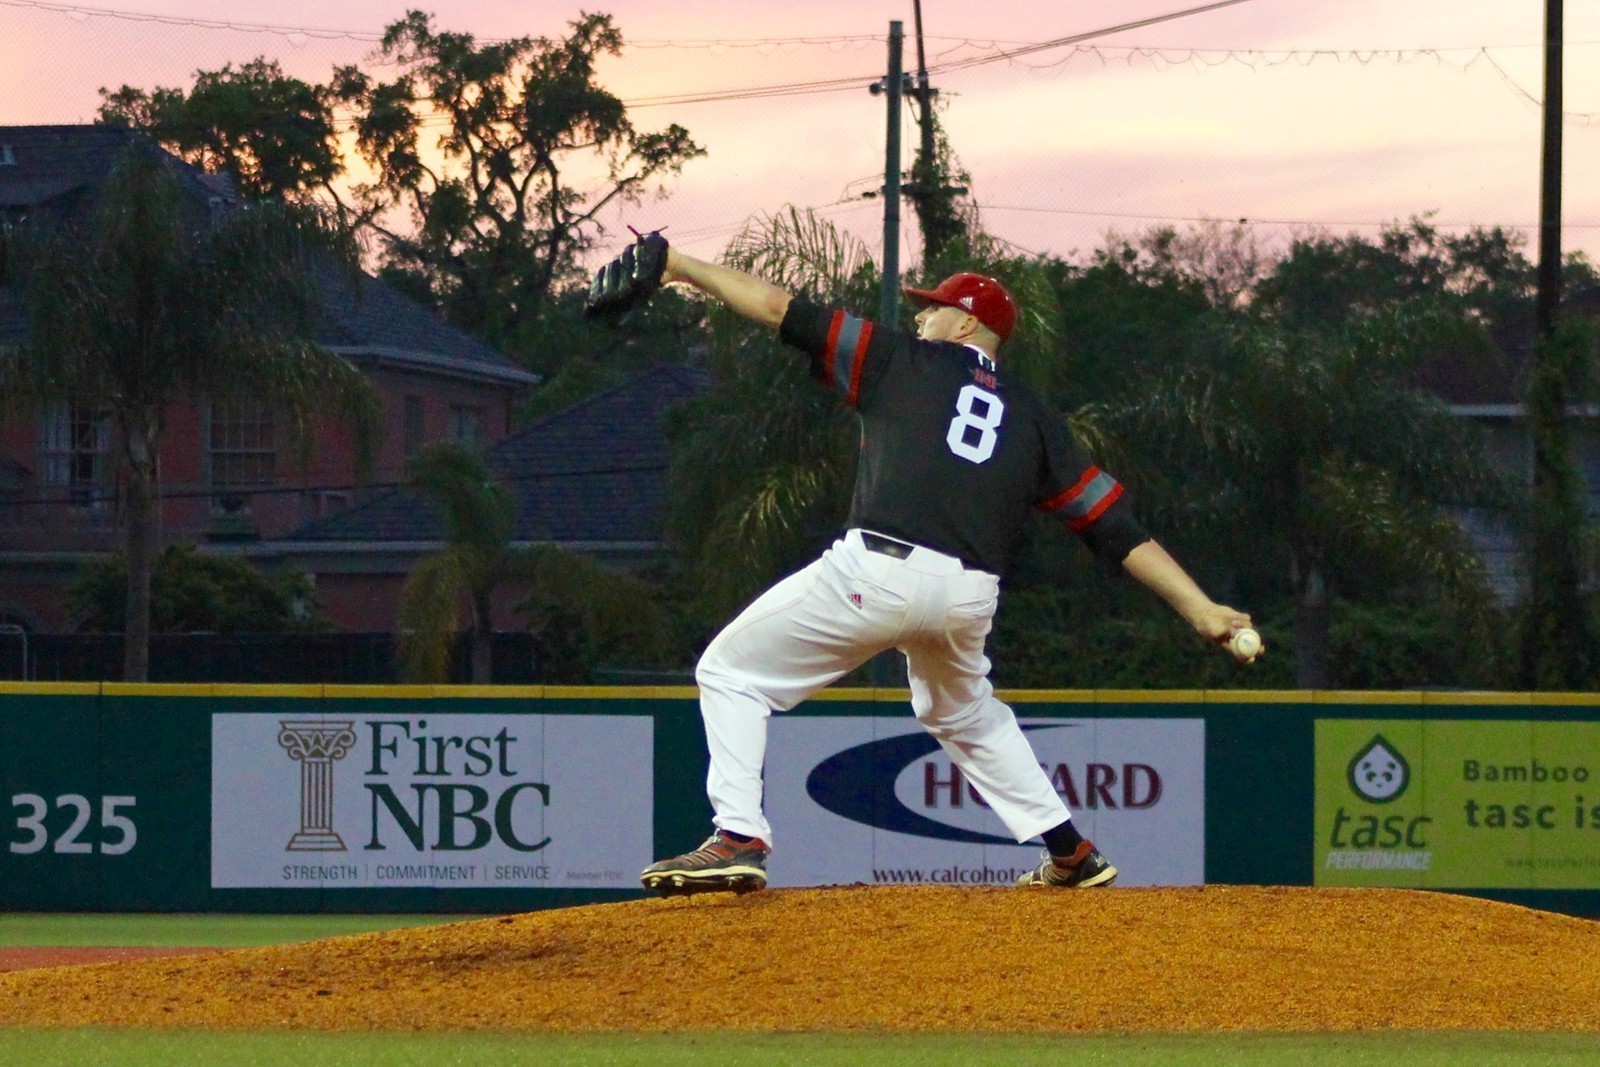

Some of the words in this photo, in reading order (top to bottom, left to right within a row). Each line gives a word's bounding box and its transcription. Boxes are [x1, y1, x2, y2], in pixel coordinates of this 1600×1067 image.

[946, 384, 1005, 464] 8
[364, 719, 518, 777] First
[923, 762, 1162, 810] HARD
[1463, 760, 1589, 782] Bamboo
[9, 793, 138, 855] 325
[363, 782, 551, 852] NBC
[1330, 807, 1433, 848] tasc
[1465, 799, 1554, 829] tasc
[282, 865, 358, 880] STRENGTH
[376, 865, 475, 880] COMMITMENT
[494, 865, 551, 880] SERVICE
[1325, 851, 1432, 870] PERFORMANCE
